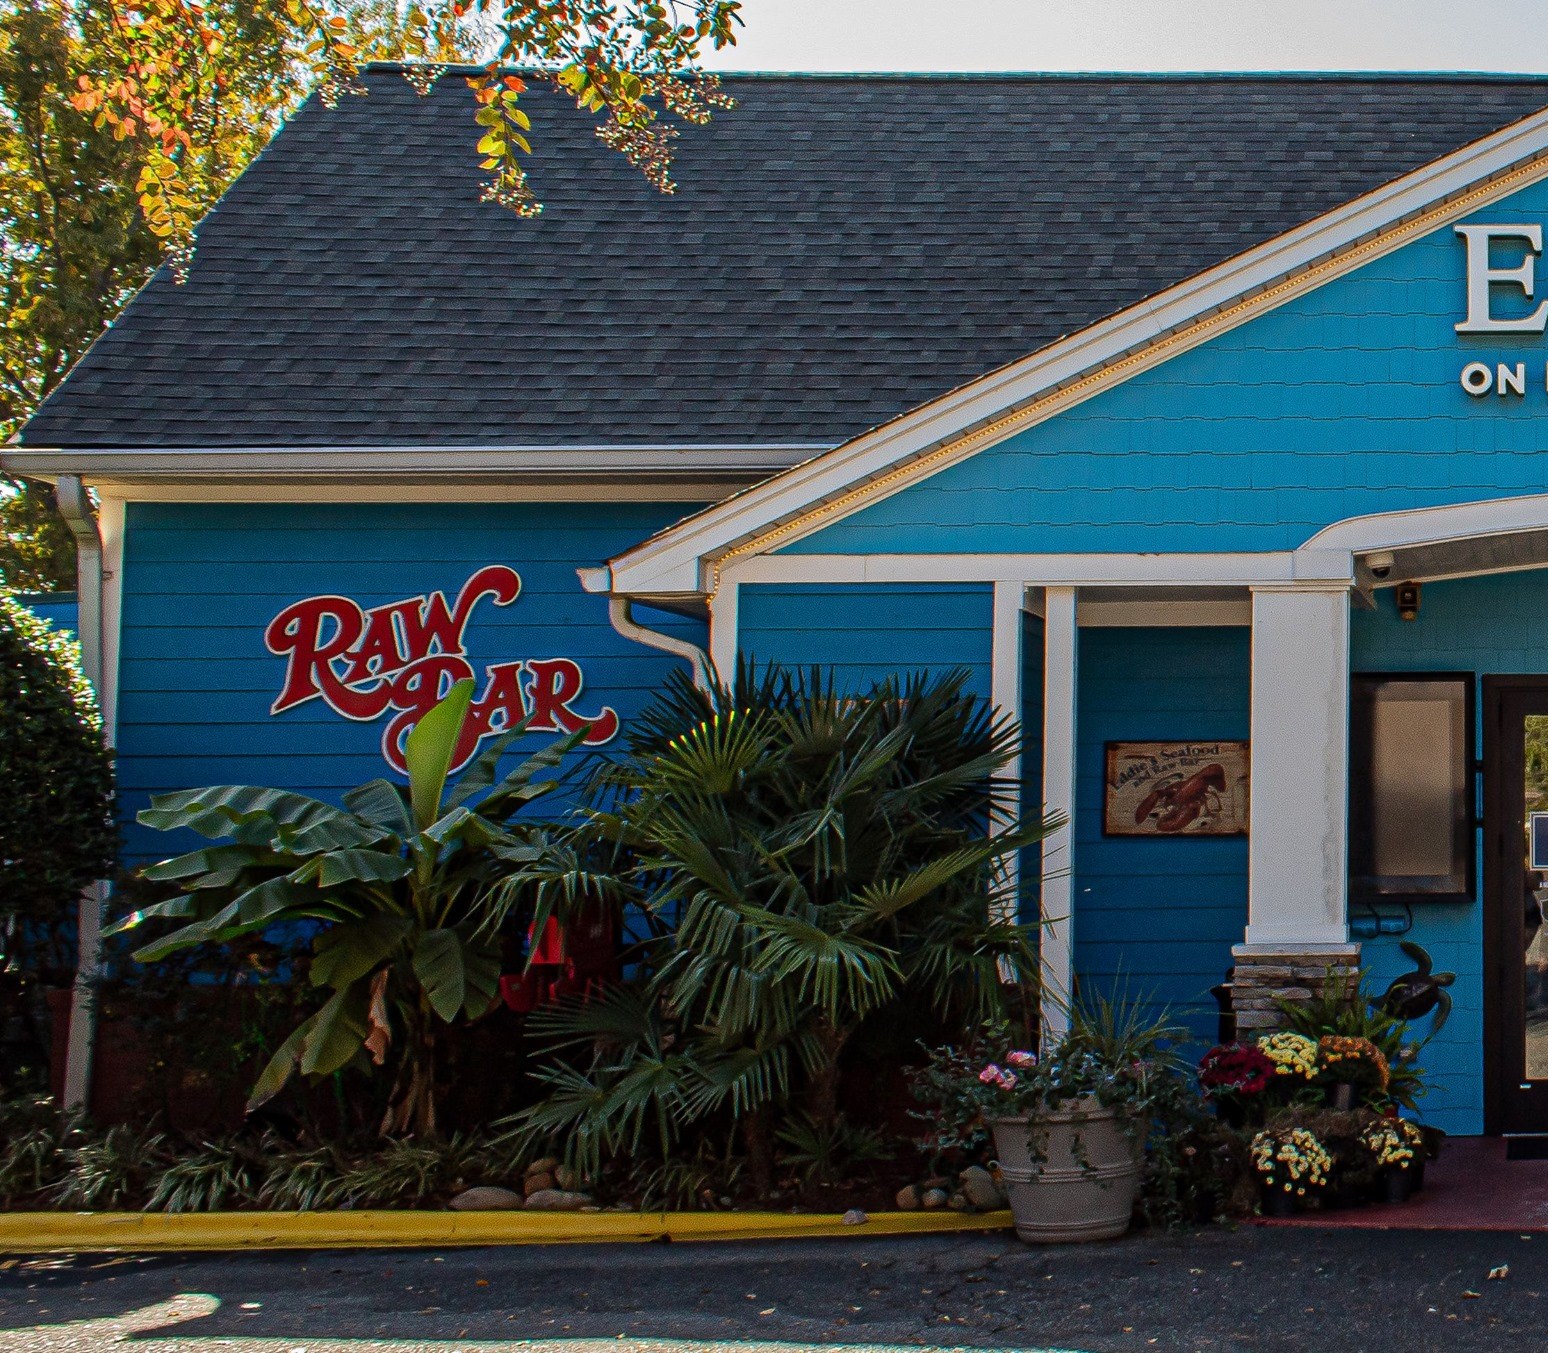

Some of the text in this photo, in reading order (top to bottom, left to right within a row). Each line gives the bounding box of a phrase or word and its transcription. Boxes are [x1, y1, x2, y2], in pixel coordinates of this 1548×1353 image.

[1460, 361, 1525, 395] ON
[264, 565, 521, 720] RAW
[381, 654, 619, 776] BAR
